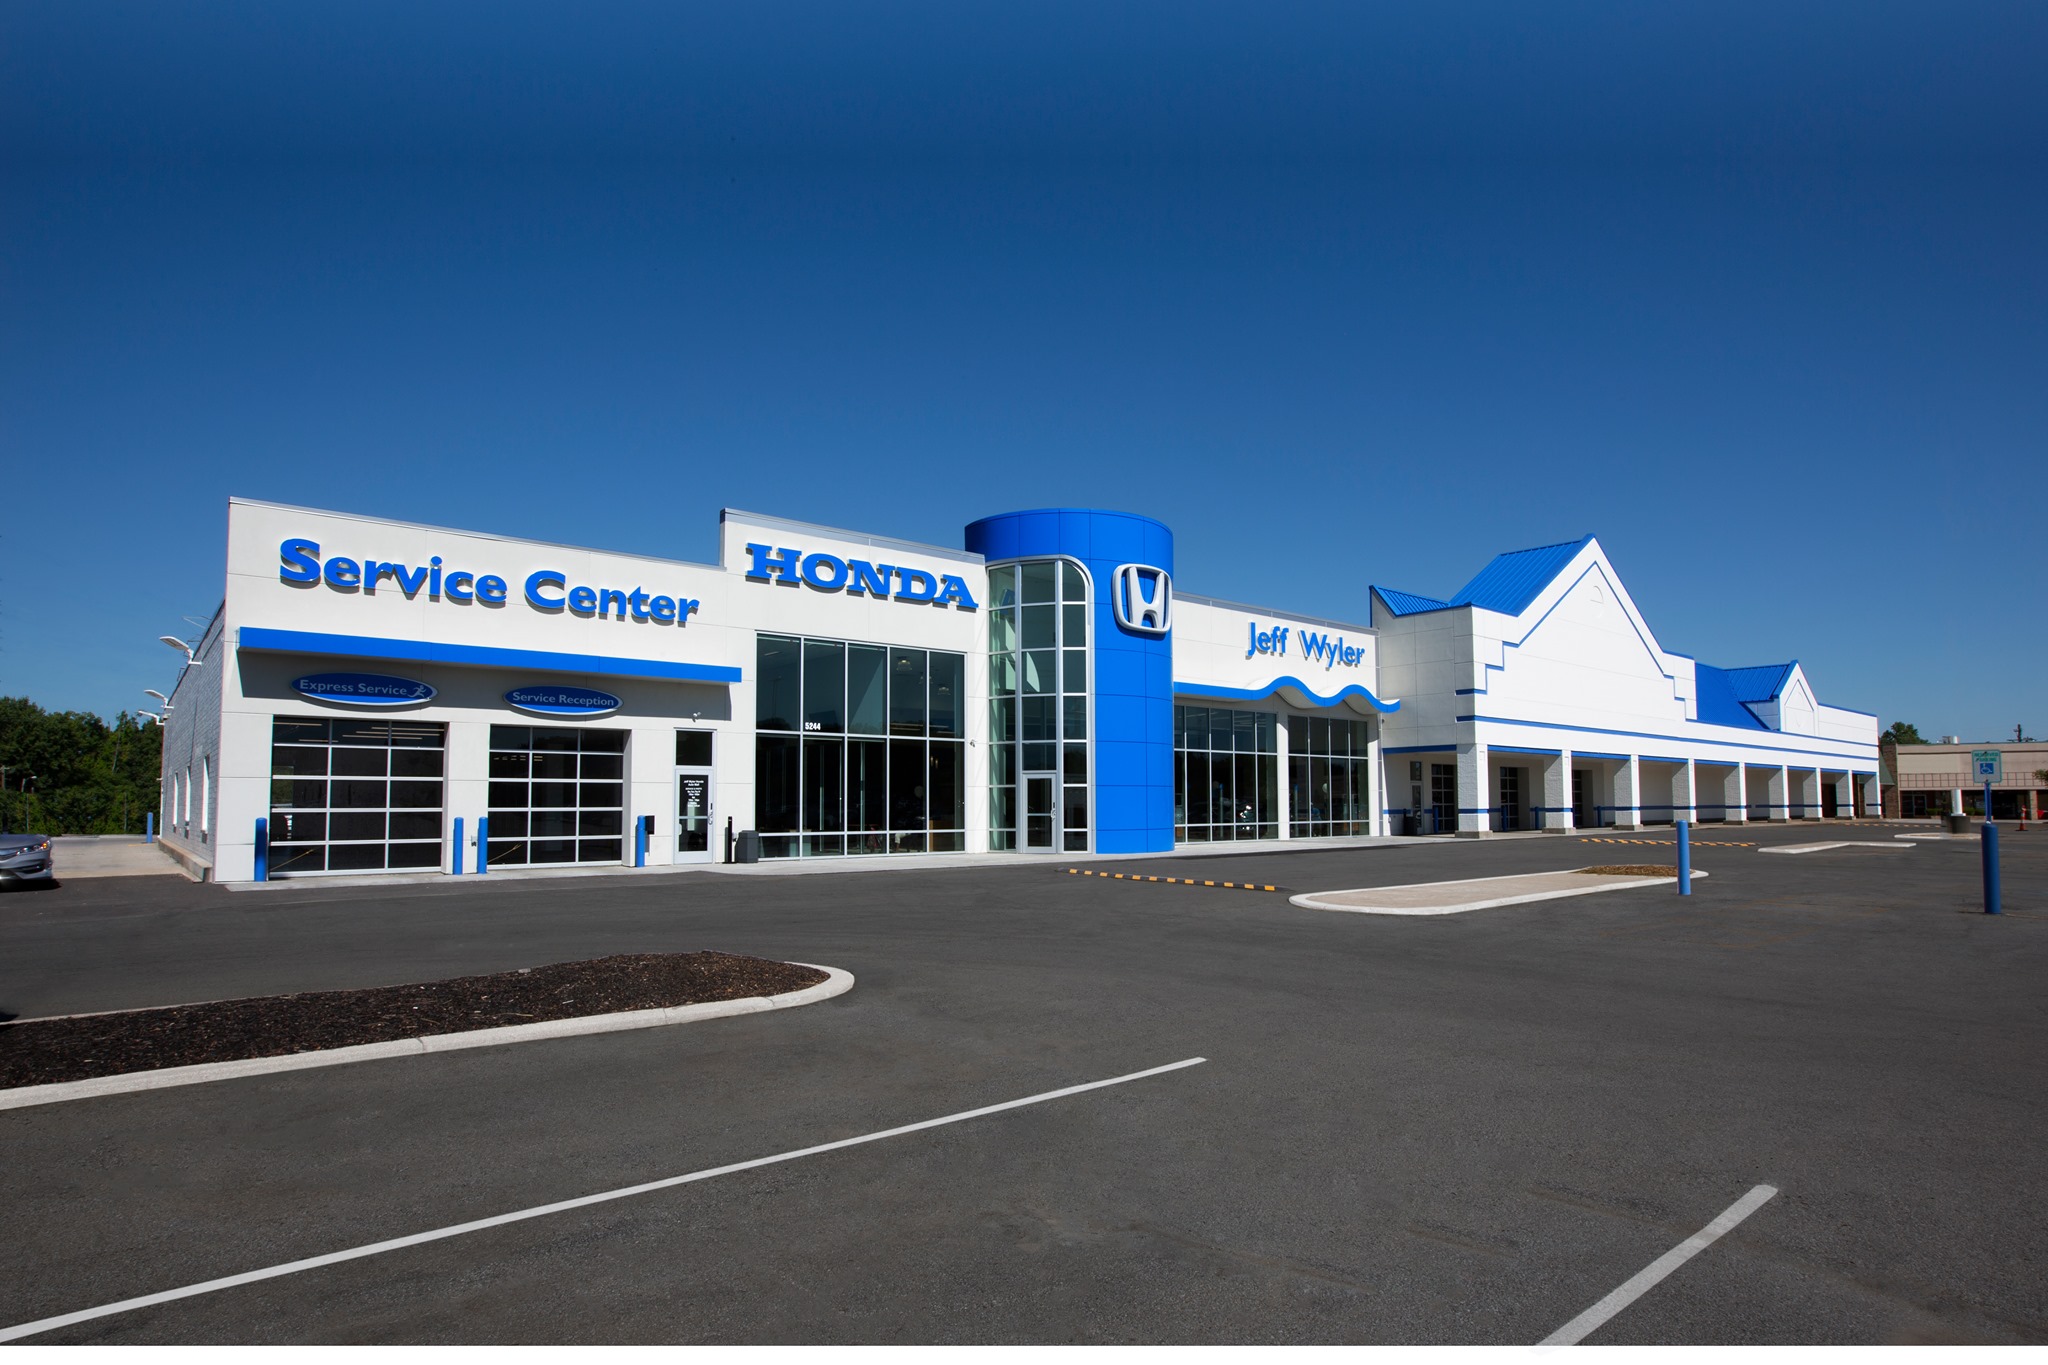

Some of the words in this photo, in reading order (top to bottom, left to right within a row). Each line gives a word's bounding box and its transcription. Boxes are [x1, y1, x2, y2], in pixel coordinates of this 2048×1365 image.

[280, 538, 508, 604] Service
[525, 570, 699, 623] Center
[746, 543, 979, 609] HONDA
[1247, 622, 1289, 657] Jeff
[1300, 630, 1365, 668] Wyler
[300, 679, 354, 693] Express
[358, 683, 407, 695] Service
[512, 691, 556, 703] Service
[559, 694, 614, 707] Reception
[804, 721, 821, 731] 5244
